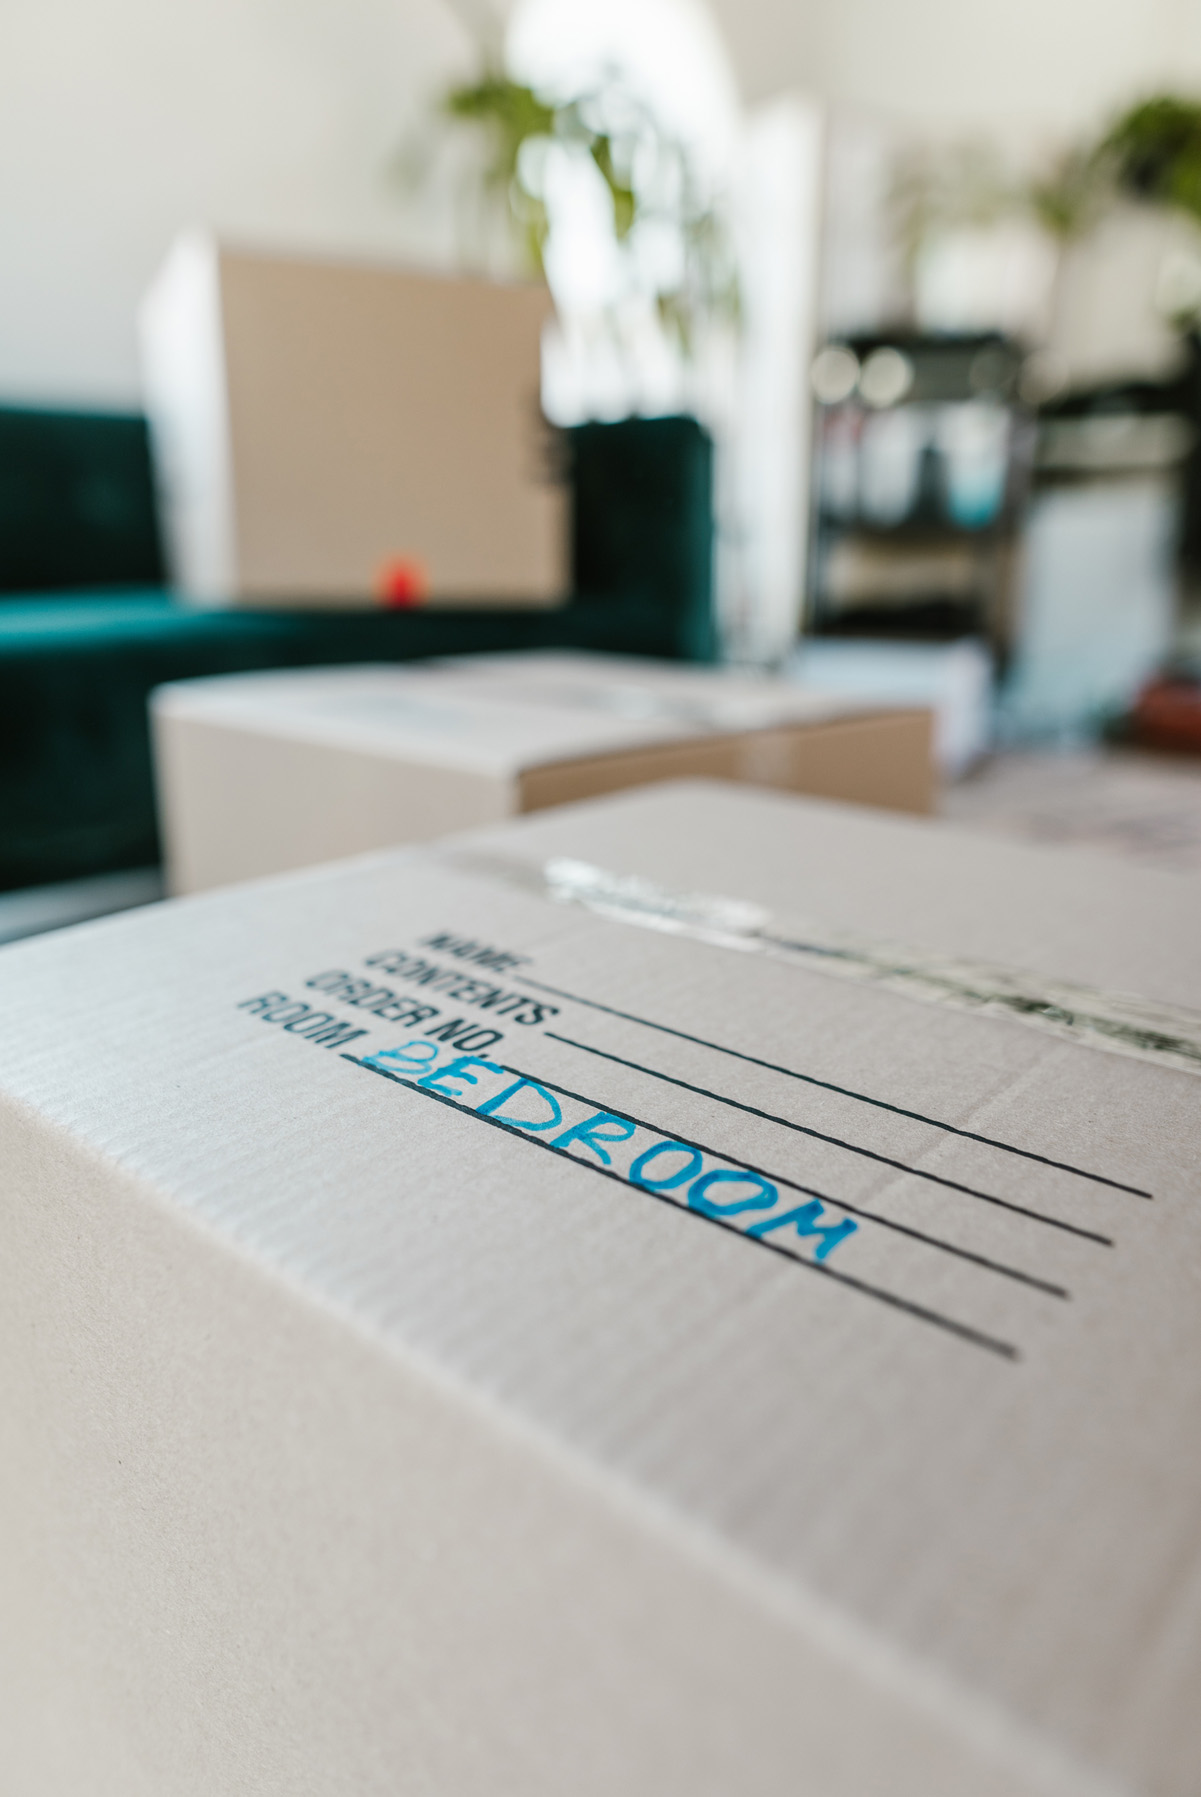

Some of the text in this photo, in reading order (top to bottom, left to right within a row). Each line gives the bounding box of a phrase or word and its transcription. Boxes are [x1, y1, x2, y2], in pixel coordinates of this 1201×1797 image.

[364, 949, 560, 1027] CONTENTS
[420, 930, 533, 972] NAME
[238, 990, 369, 1050] ROOM
[304, 968, 504, 1060] ORDER NO.
[358, 1040, 858, 1264] BEDROOM
